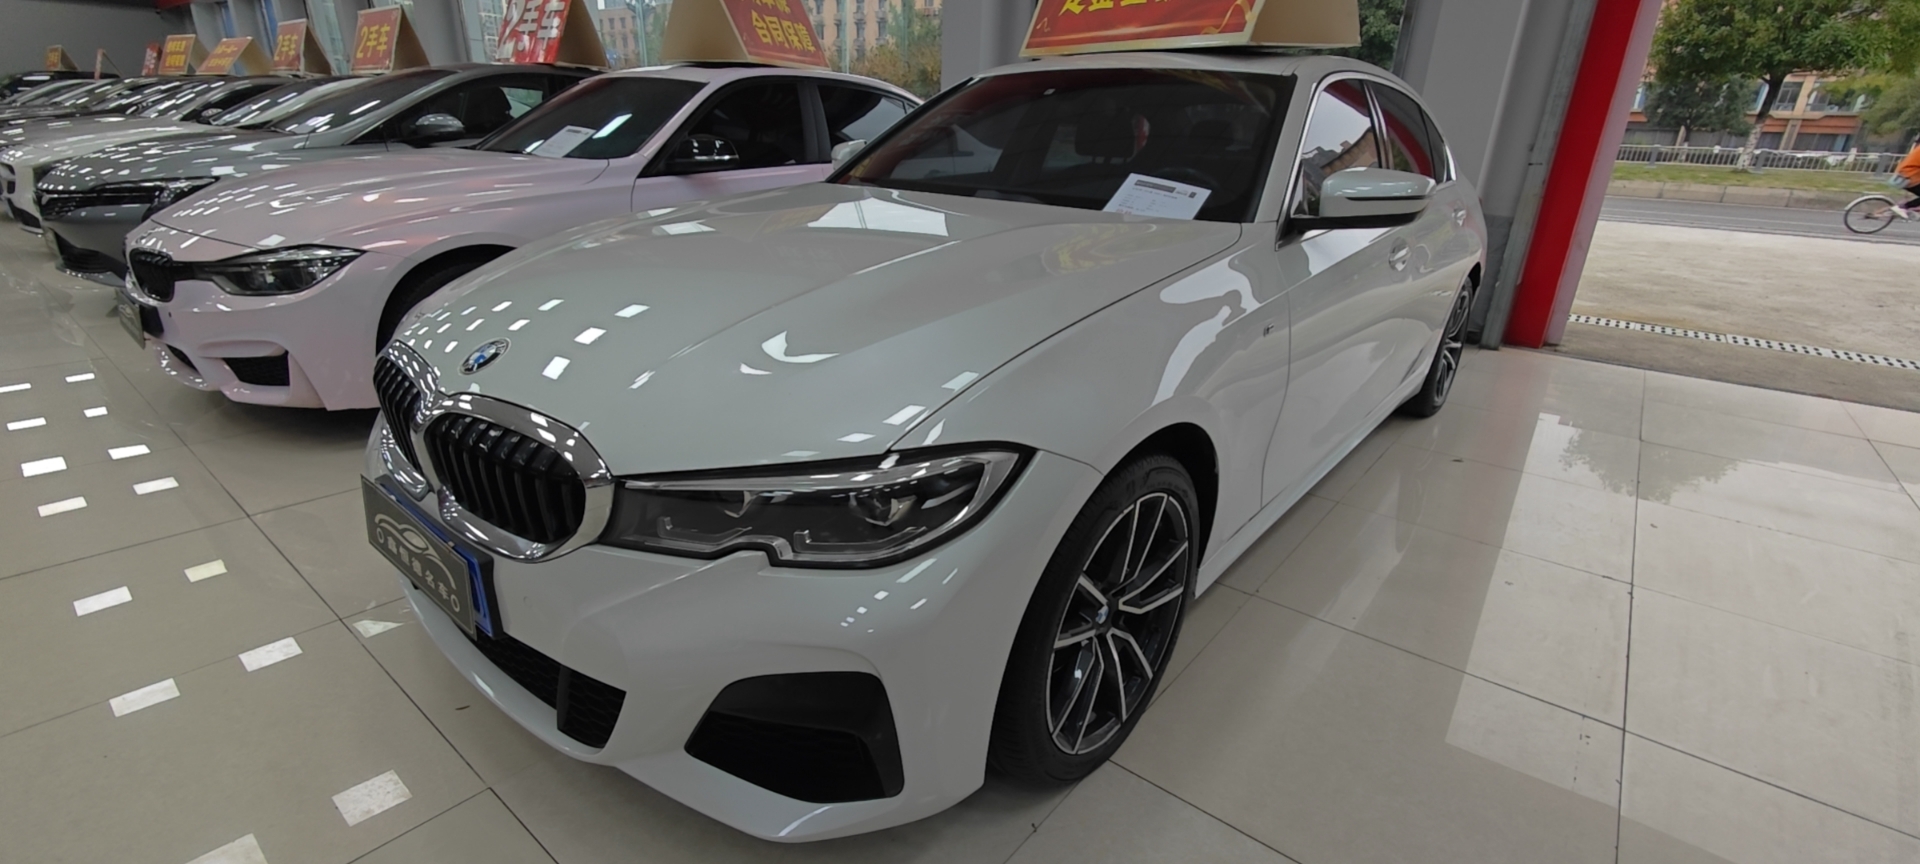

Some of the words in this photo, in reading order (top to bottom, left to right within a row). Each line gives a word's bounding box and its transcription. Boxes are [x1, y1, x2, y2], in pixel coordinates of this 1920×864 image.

[273, 32, 298, 61] 2手车
[356, 23, 391, 59] 2手车
[495, 0, 566, 59] 2手车
[751, 9, 817, 53] 合同保障
